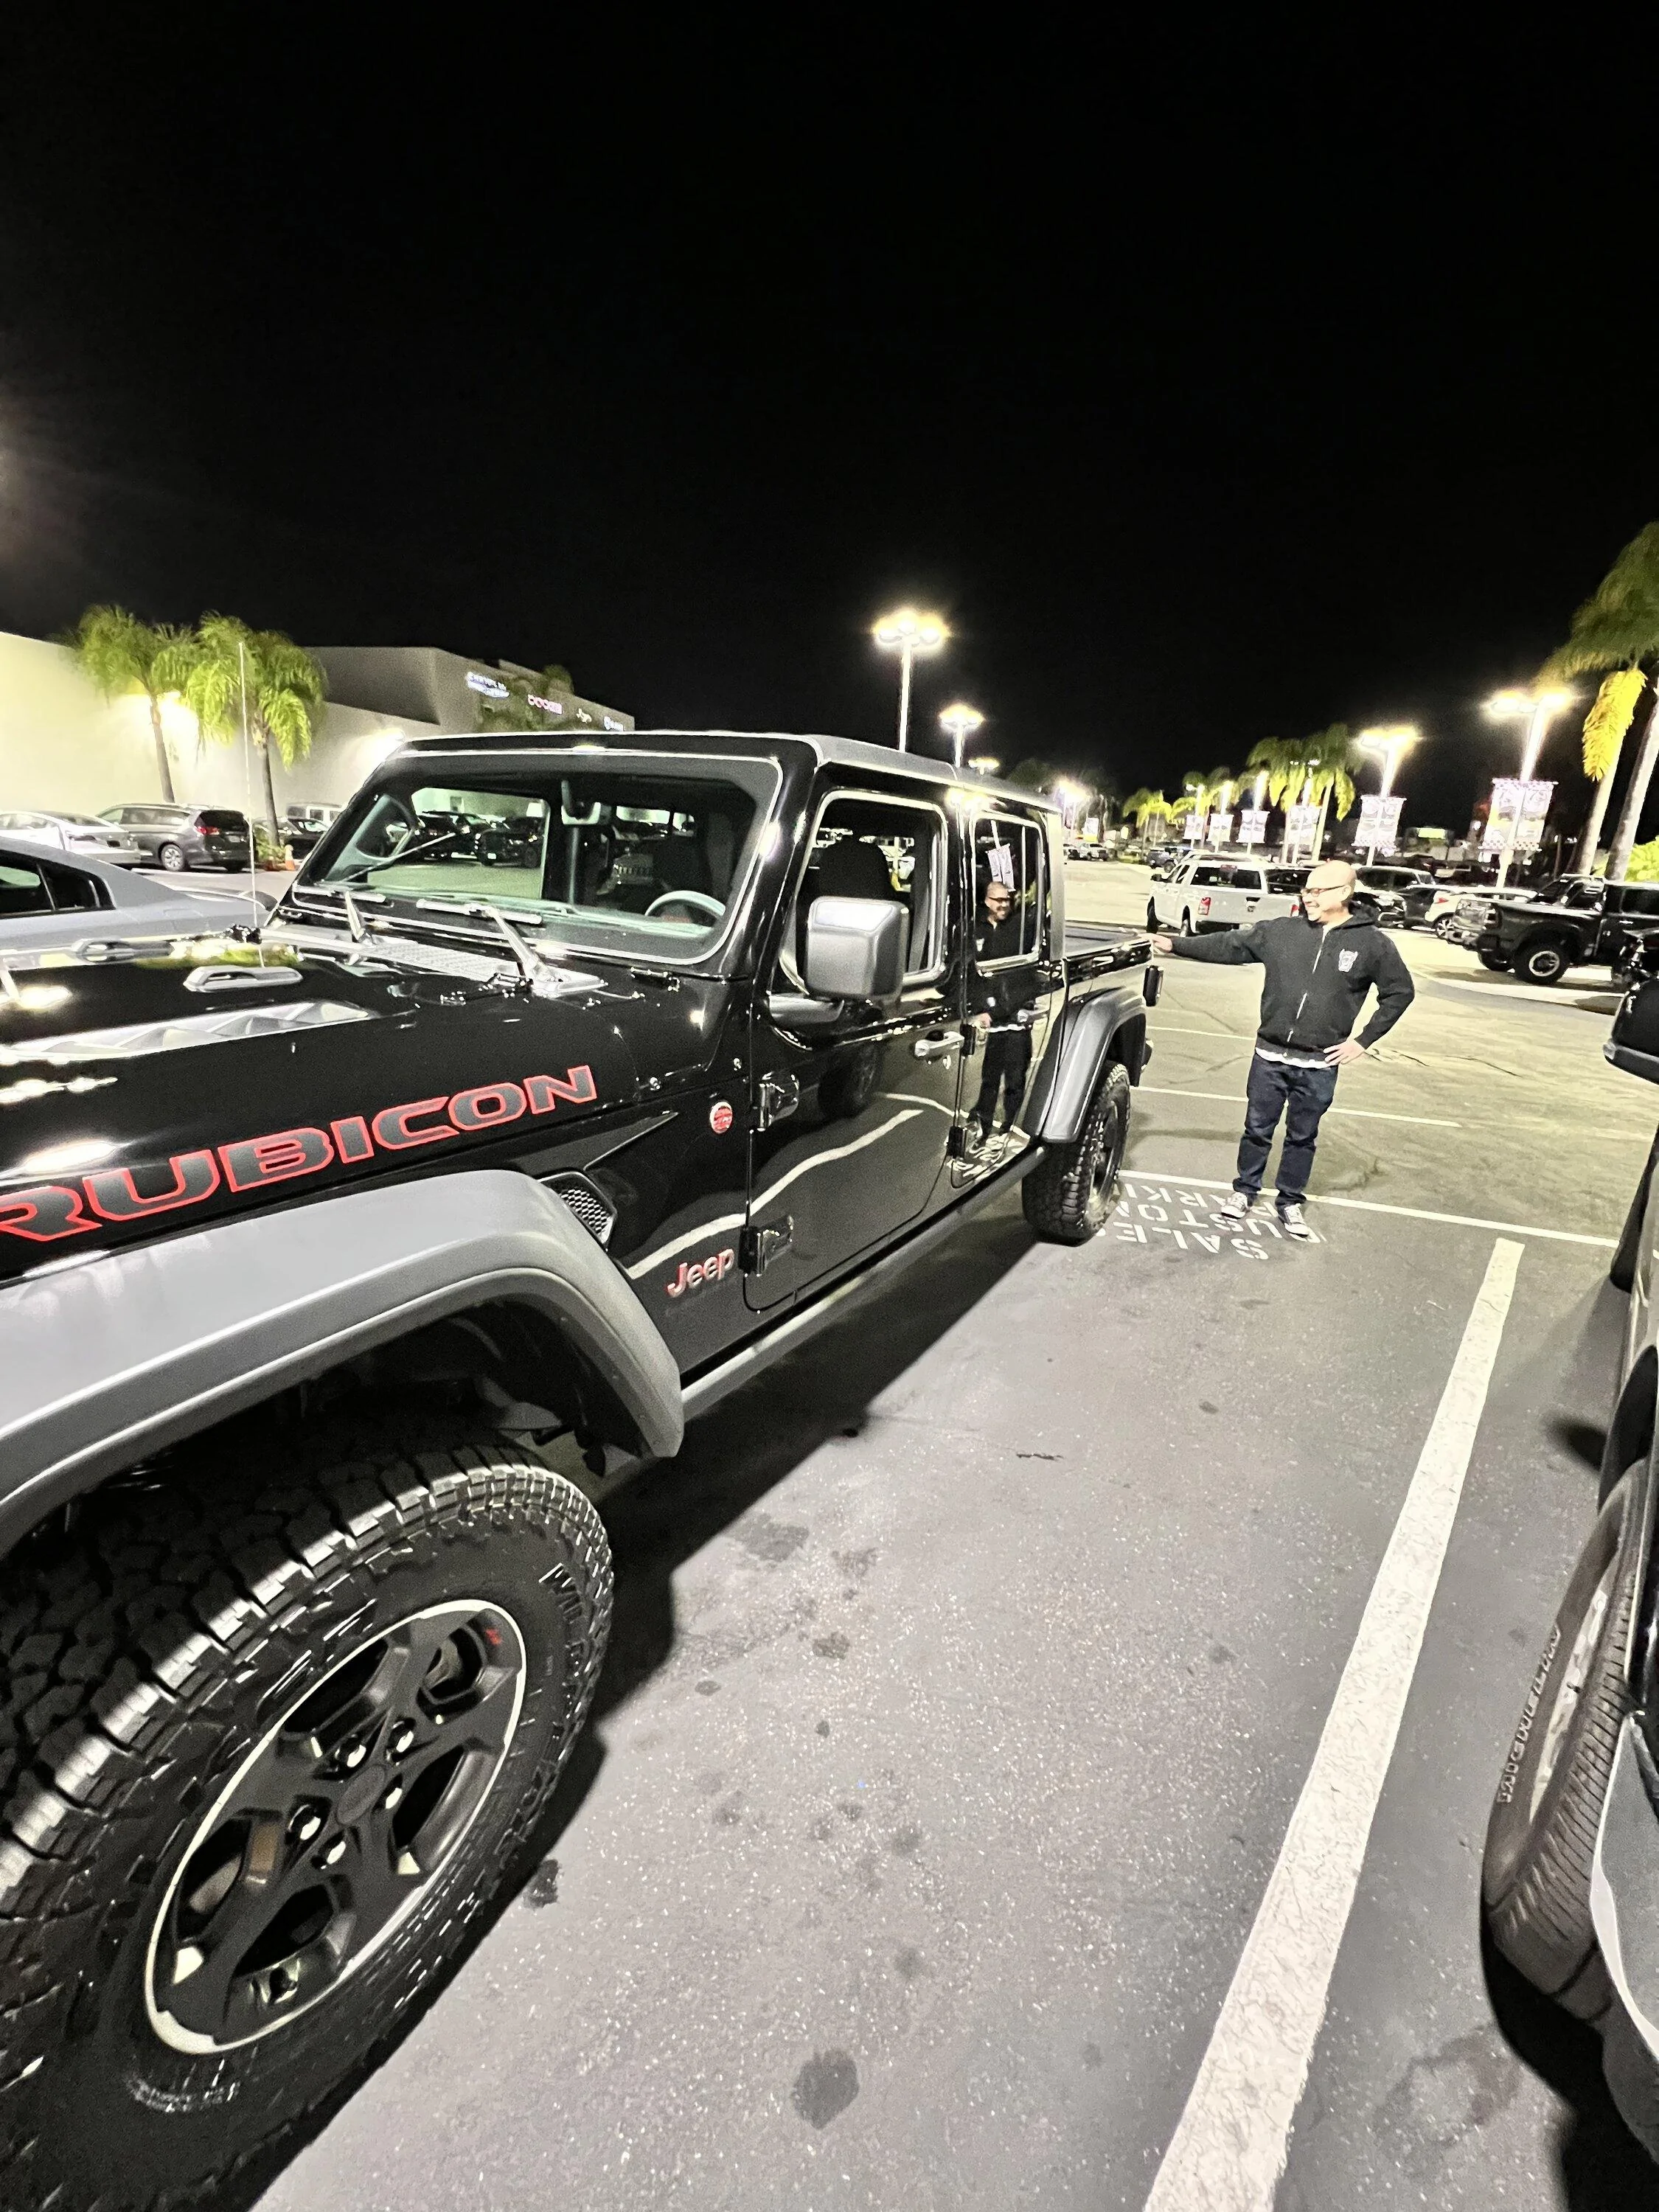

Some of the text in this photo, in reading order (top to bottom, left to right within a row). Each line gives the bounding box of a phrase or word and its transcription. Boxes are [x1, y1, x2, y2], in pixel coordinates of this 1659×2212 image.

[0, 1065, 596, 1242] RUBICON
[1096, 1221, 1269, 1260] SALE
[667, 1248, 734, 1298] Jeep
